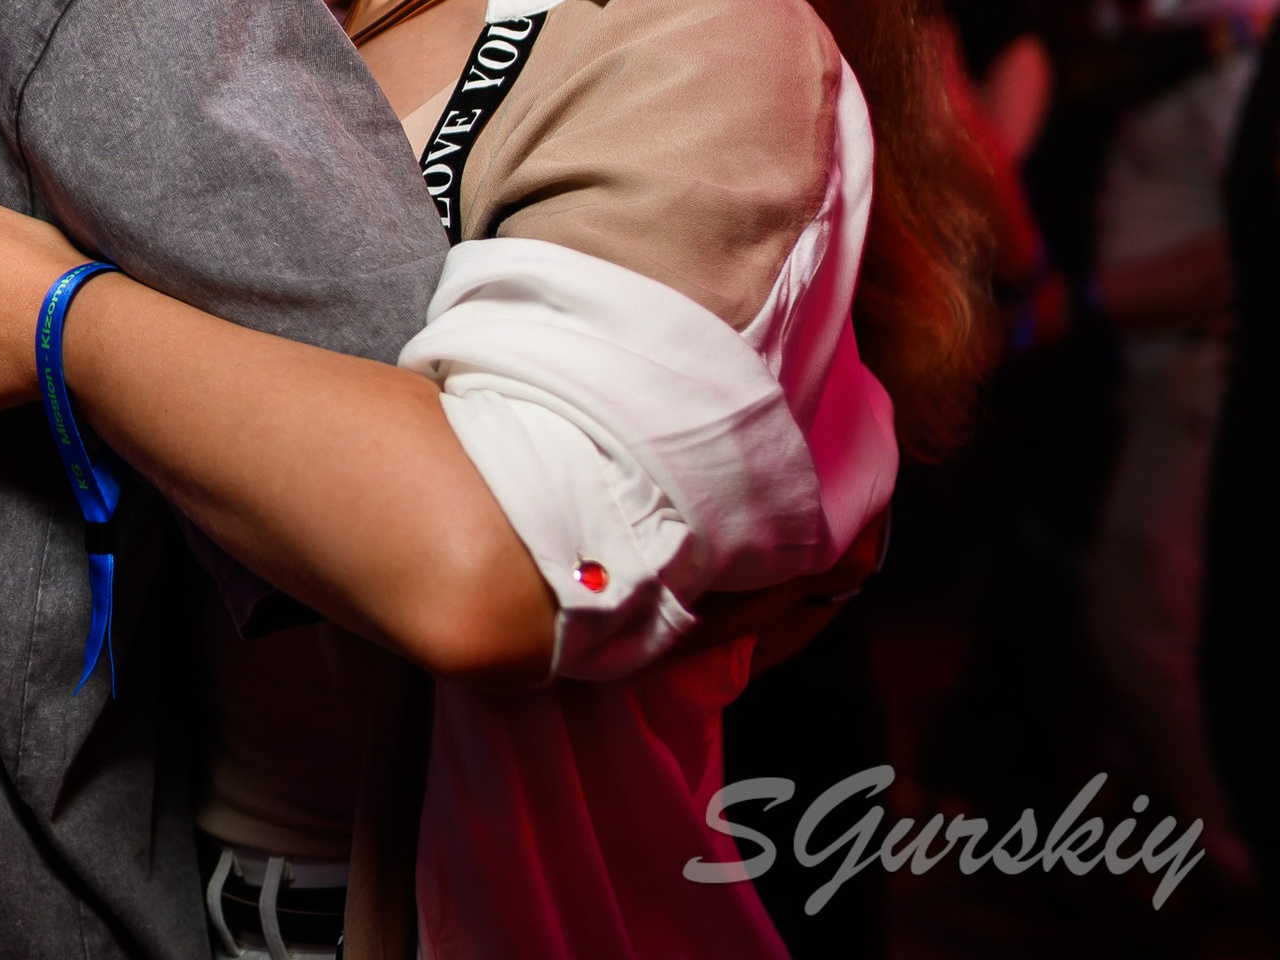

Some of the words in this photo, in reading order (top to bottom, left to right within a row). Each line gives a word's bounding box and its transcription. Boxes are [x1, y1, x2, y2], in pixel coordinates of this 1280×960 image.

[422, 108, 482, 229] LOVE
[461, 15, 533, 93] YOU
[44, 367, 71, 446] Mission
